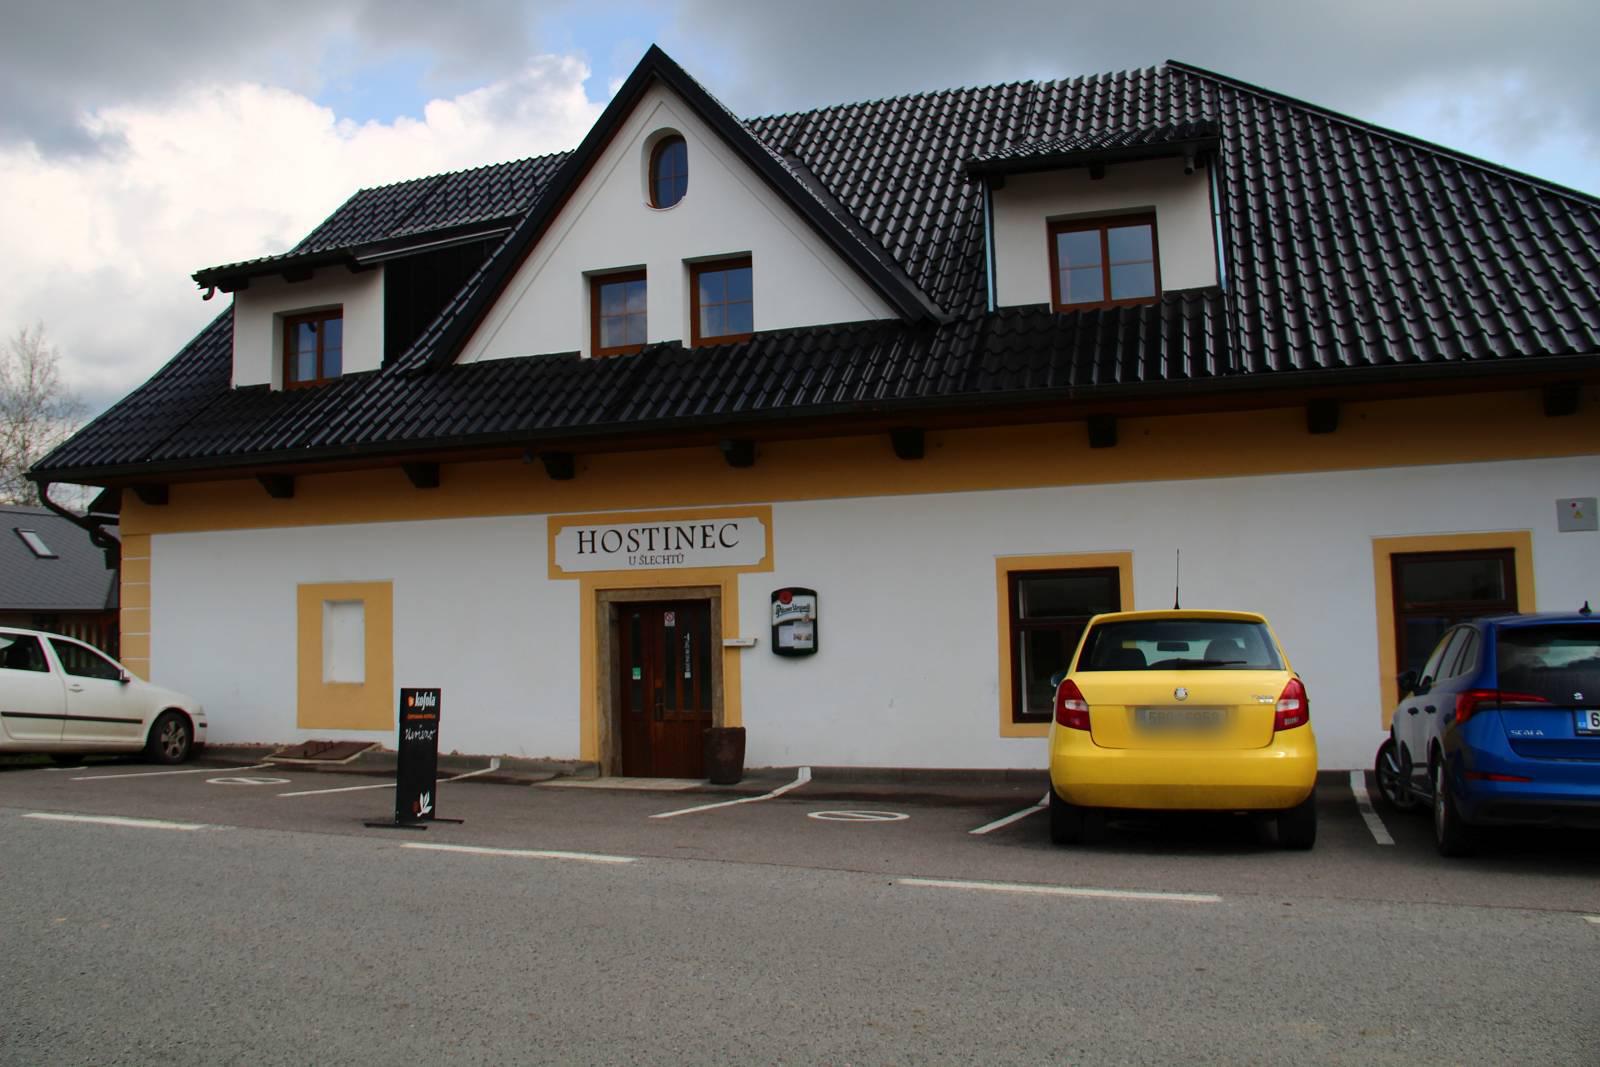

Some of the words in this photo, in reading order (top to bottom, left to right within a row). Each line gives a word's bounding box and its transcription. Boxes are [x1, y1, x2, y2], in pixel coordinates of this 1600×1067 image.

[577, 523, 740, 554] HOSTINEC
[628, 556, 637, 566] U
[638, 553, 684, 566] ŠLECHTŮ
[415, 691, 436, 711] kofola
